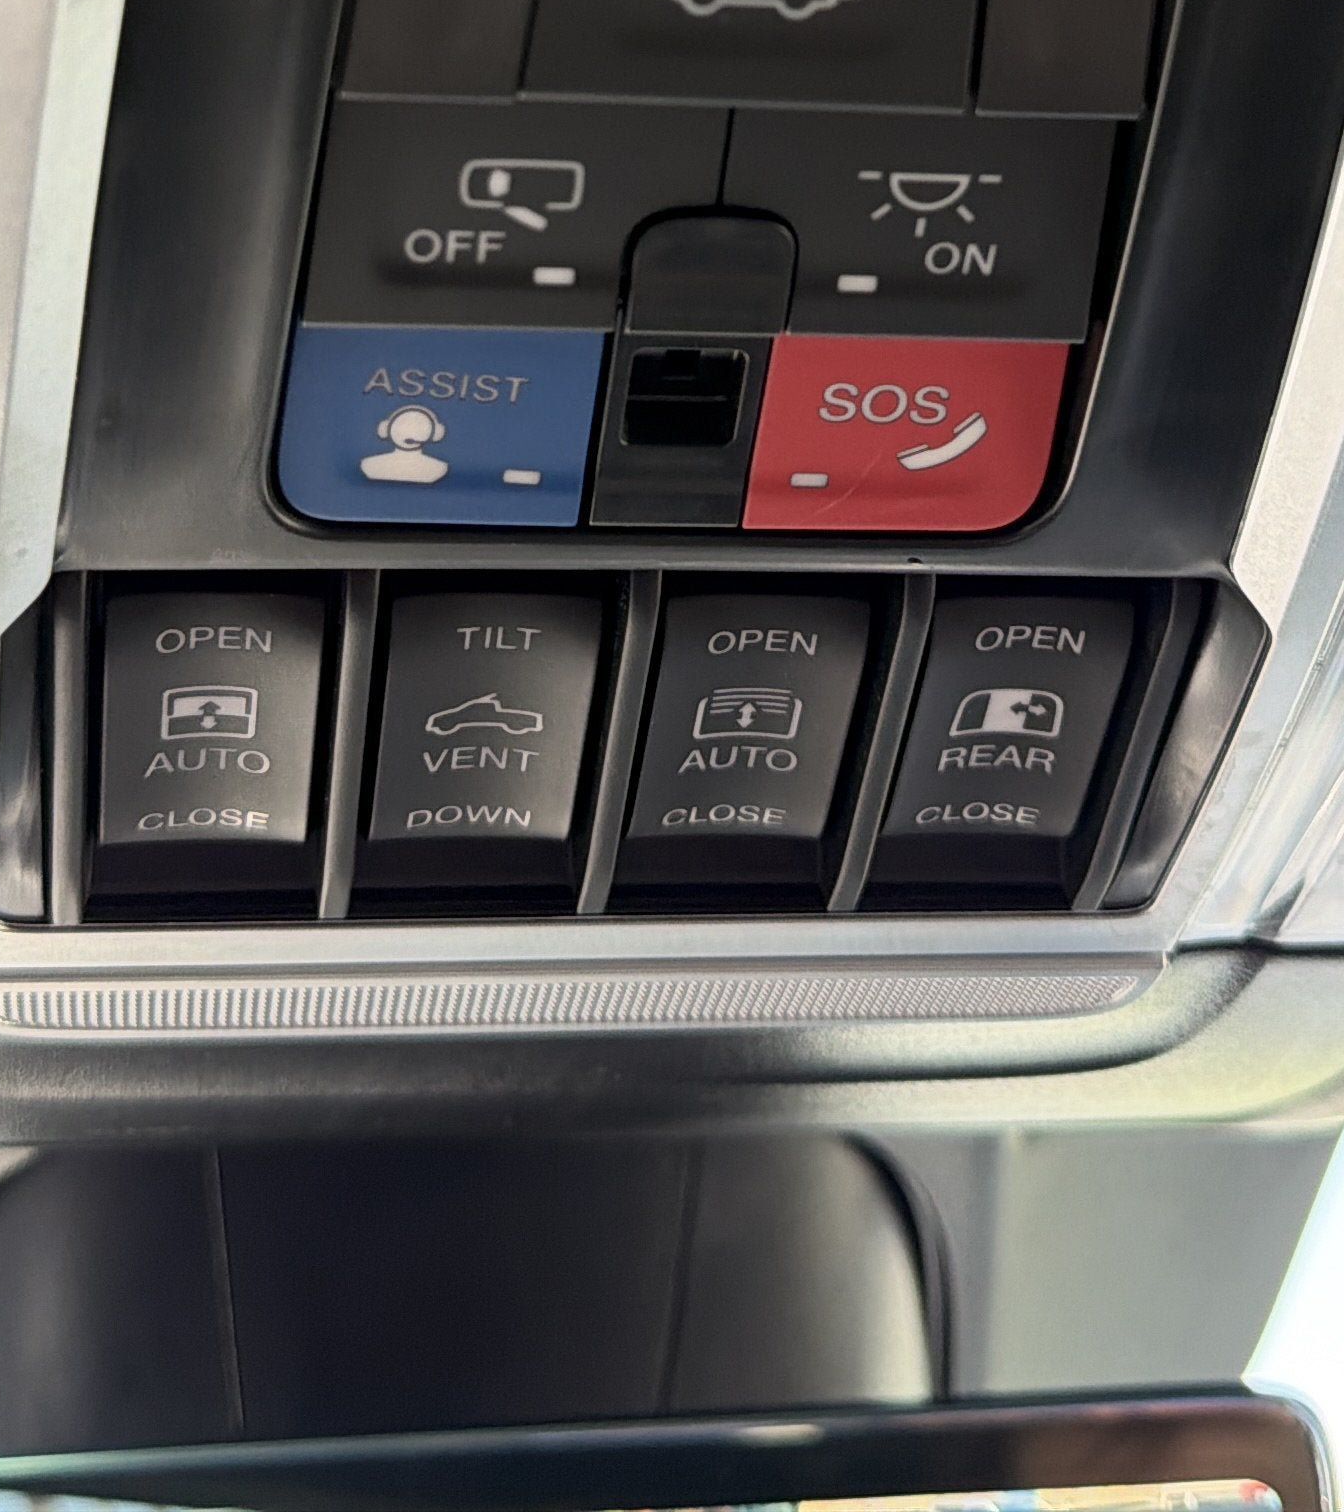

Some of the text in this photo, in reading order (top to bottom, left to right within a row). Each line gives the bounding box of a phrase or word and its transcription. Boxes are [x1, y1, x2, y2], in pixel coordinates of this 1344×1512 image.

[403, 228, 507, 266] OFF
[923, 241, 999, 277] ON
[361, 366, 530, 403] ASSIST
[818, 383, 951, 427] SOS
[155, 626, 273, 654] OPEN
[457, 625, 542, 651] TILT
[707, 629, 818, 656] OPEN
[974, 625, 1086, 655] OPEN
[144, 747, 271, 778] AUTO
[422, 745, 540, 773] VENT
[677, 745, 798, 775] AUTO
[937, 744, 1056, 775] REAR
[137, 807, 271, 832] CLOSE
[406, 804, 532, 829] DOWN
[661, 803, 787, 828] CLOSE
[914, 801, 1041, 826] CLOSE
